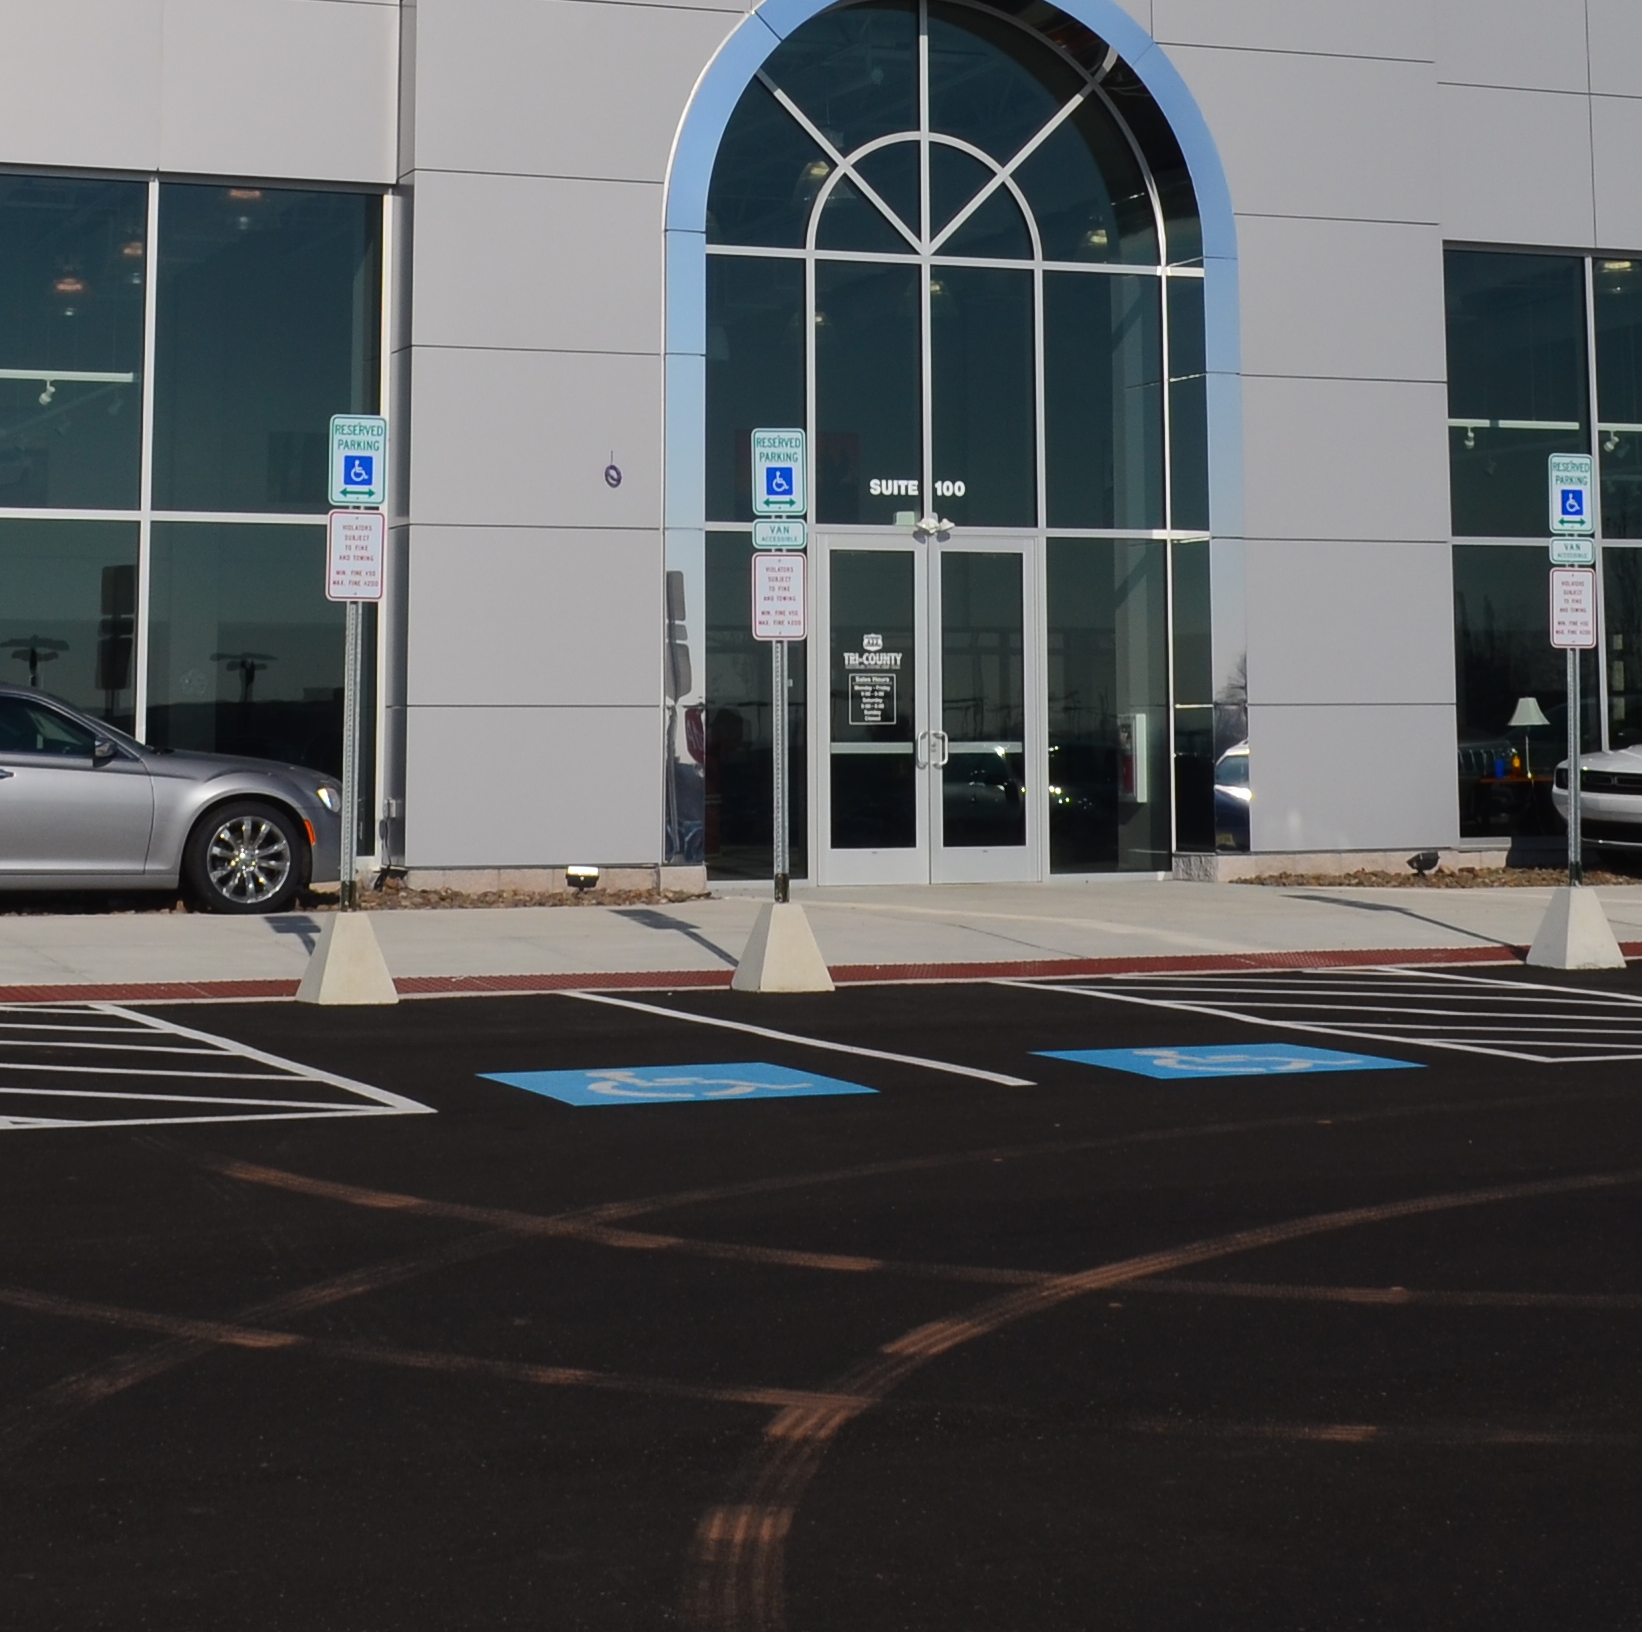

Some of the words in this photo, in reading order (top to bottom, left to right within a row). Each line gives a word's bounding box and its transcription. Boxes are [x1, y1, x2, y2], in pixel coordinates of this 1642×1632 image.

[334, 424, 384, 437] RESERVED
[337, 438, 380, 452] PARKING
[756, 437, 801, 448] RESERVED
[759, 451, 799, 463] PARKING
[1552, 461, 1590, 473] RESERVED
[1556, 475, 1588, 486] PARKING
[869, 478, 919, 496] SUITE
[934, 480, 966, 497] 100
[769, 525, 790, 534] VAN
[1563, 543, 1581, 551] VAN
[843, 652, 903, 665] TRI-COUNTY
